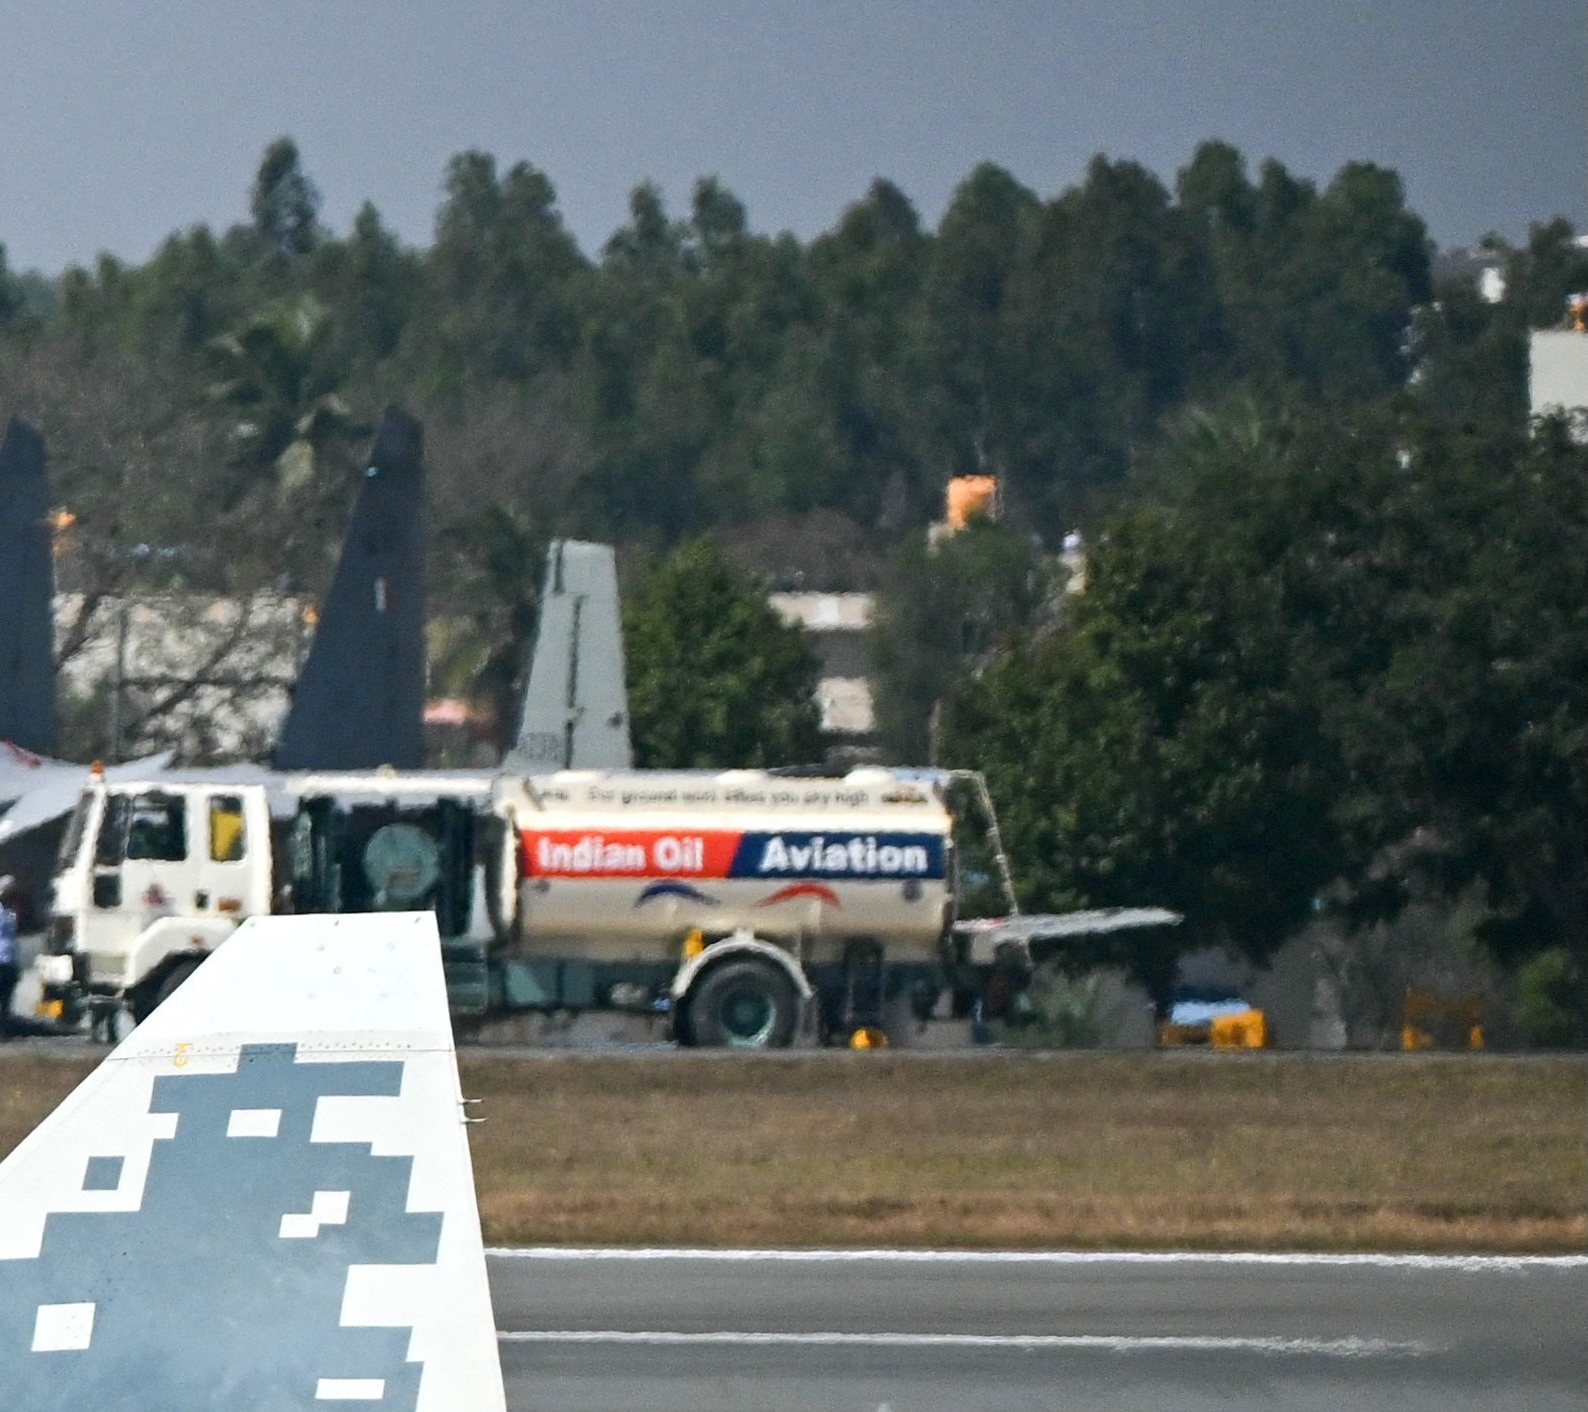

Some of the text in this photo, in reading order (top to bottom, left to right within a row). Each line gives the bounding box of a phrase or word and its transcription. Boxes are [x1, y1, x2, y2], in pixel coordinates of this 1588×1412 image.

[537, 835, 929, 873] Indian Oil Aviation
